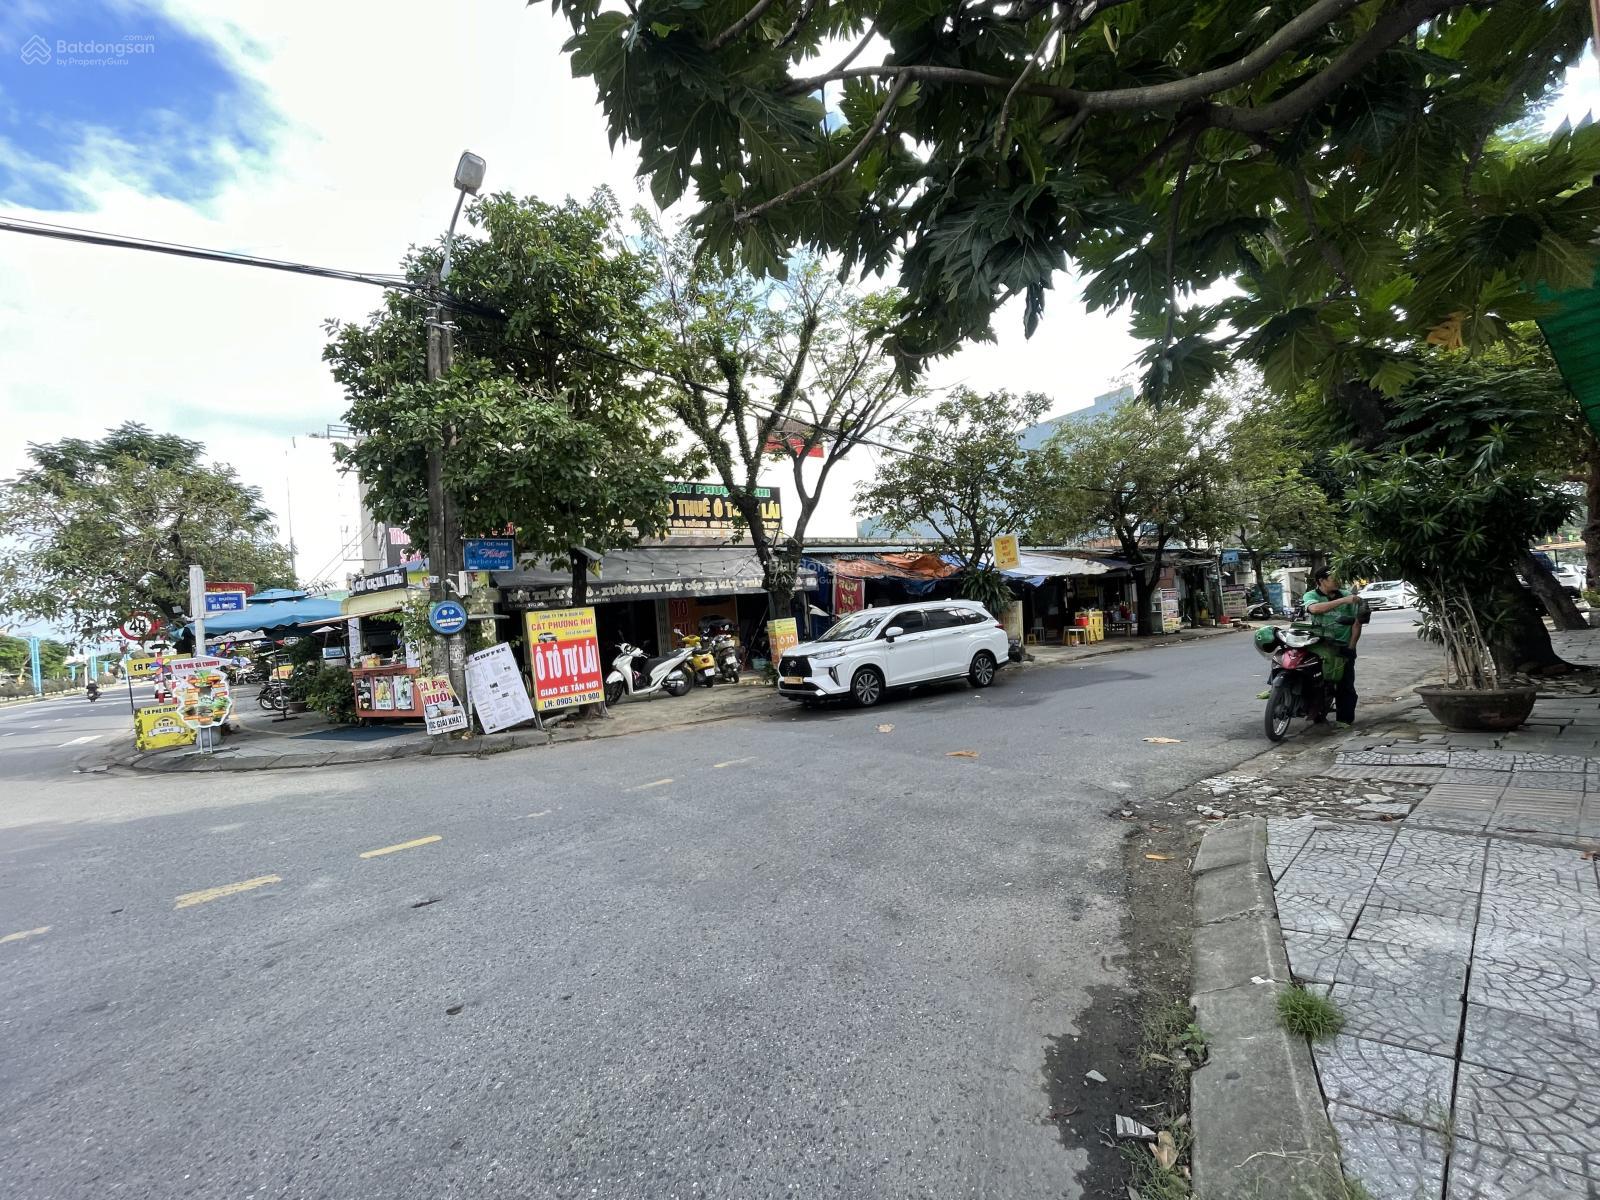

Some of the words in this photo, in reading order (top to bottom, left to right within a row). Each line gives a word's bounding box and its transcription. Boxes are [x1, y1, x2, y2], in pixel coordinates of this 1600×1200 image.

[676, 498, 711, 516] THUÊ
[714, 498, 723, 518] Ô
[761, 500, 780, 519] LÁI
[640, 583, 664, 594] MAY
[704, 582, 718, 590] XE
[129, 618, 146, 632] 40
[474, 647, 506, 661] COFFEE
[536, 646, 546, 681] Ô
[546, 644, 562, 679] TÔ
[562, 644, 579, 682] TỰ
[579, 640, 598, 674] LÁI
[432, 680, 448, 690] PHÊ
[540, 688, 558, 697] GIAO
[560, 686, 570, 694] XE
[571, 682, 585, 692] TẬN
[586, 680, 599, 689] NƠI
[544, 699, 555, 708] LH:
[556, 696, 573, 706] 0905
[575, 694, 586, 702] 470
